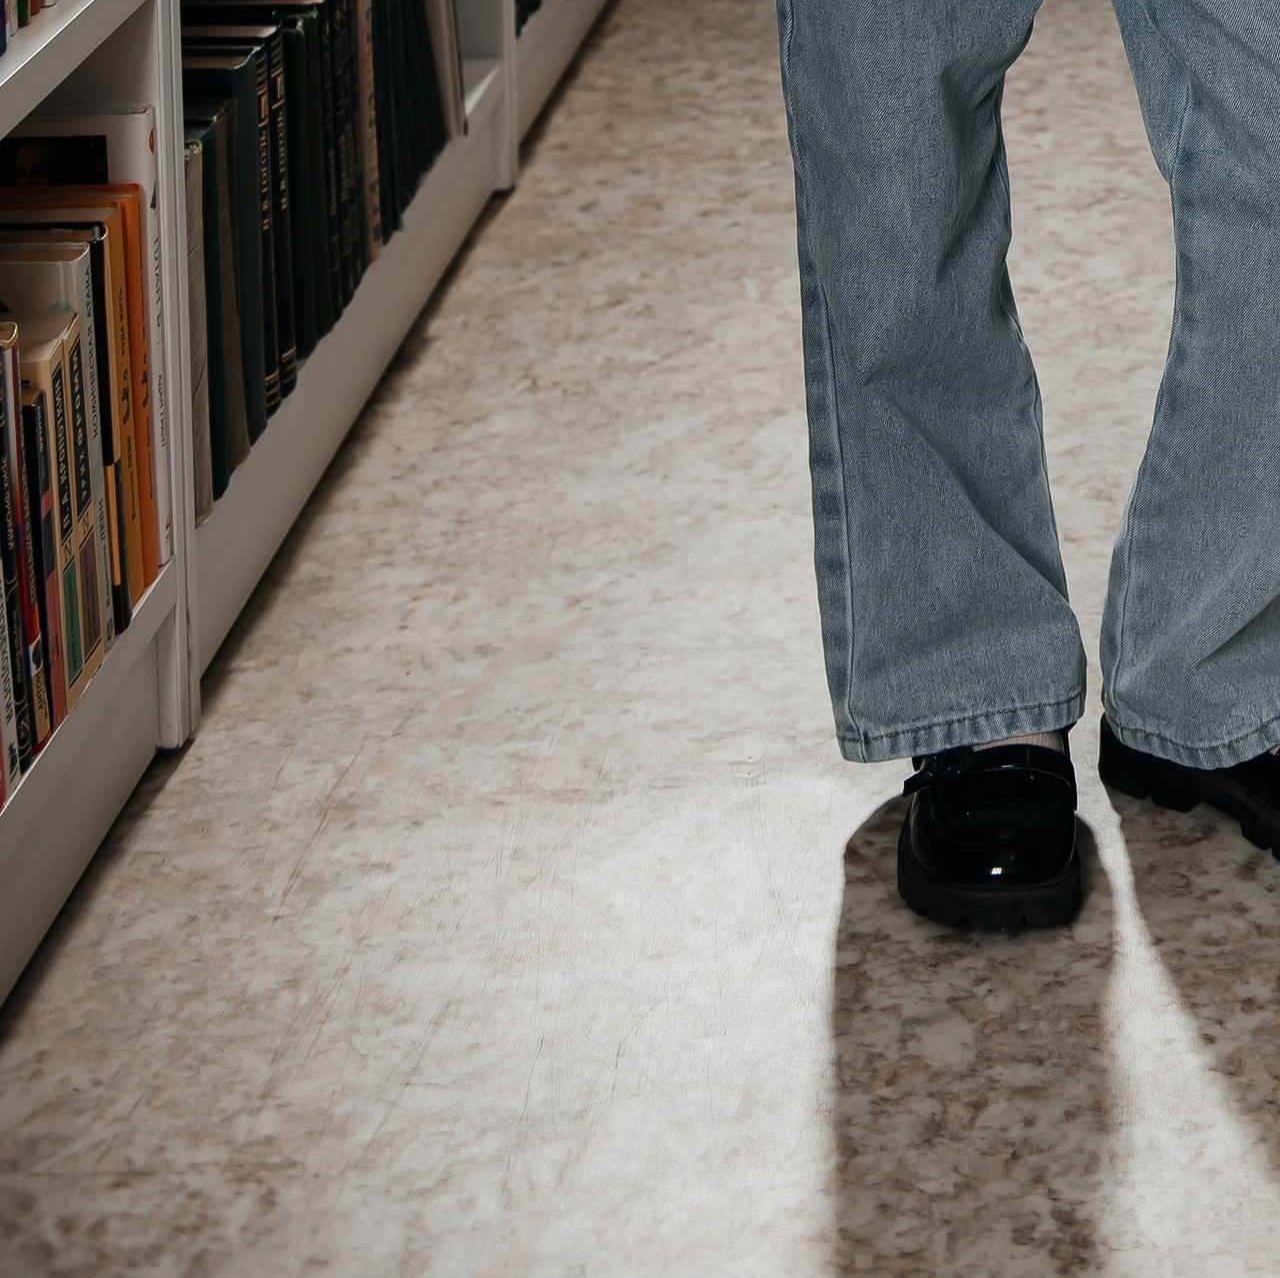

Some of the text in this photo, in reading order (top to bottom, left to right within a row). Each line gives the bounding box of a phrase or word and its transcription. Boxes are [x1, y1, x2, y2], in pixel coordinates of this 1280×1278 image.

[259, 132, 268, 194] ГОГОЛЬ
[277, 110, 285, 174] ГОГОЛЬ
[72, 350, 83, 445] ФРОММ
[87, 323, 98, 439] КОМИЧЕСКАЯ
[54, 379, 66, 485] КРОПОТКИН
[98, 497, 106, 541] ЛЕВИ
